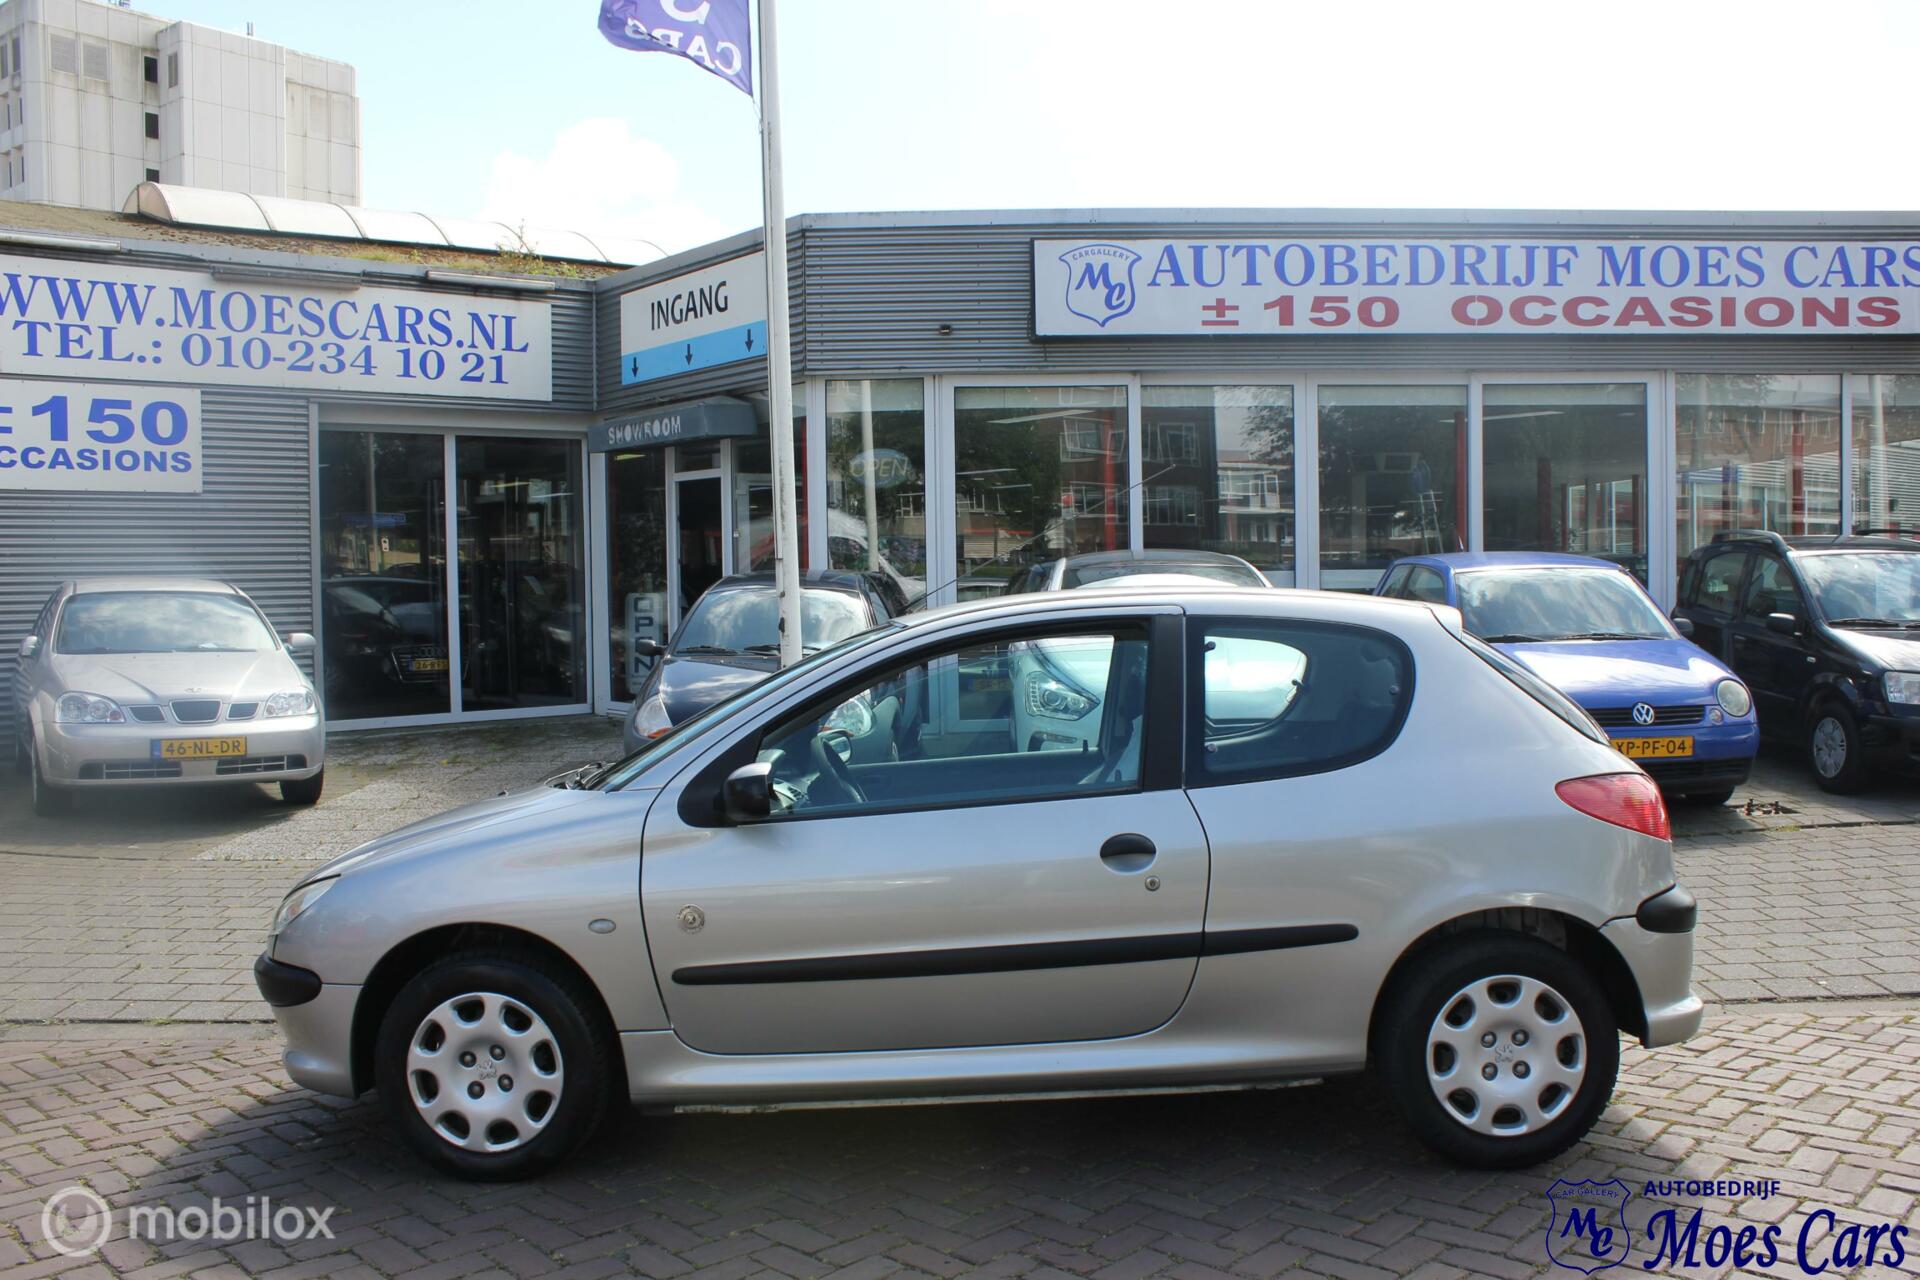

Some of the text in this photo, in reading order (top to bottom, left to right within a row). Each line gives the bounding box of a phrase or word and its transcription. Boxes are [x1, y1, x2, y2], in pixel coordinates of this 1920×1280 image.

[1147, 243, 1920, 288] AUTOBEDRIJF MOES CARS
[0, 273, 530, 353] WWW.MOESCARS.NL
[650, 280, 729, 331] INGANG
[1263, 295, 1400, 328] 150
[1450, 295, 1901, 328] OCCASIONS
[12, 319, 510, 385] TEL.: 010-234 10 21
[32, 395, 189, 446] 150
[608, 415, 681, 446] SHOWROOM
[849, 456, 908, 478] OPEN
[166, 740, 241, 756] 46-NL-DR
[1616, 739, 1686, 755] XP-PF-04
